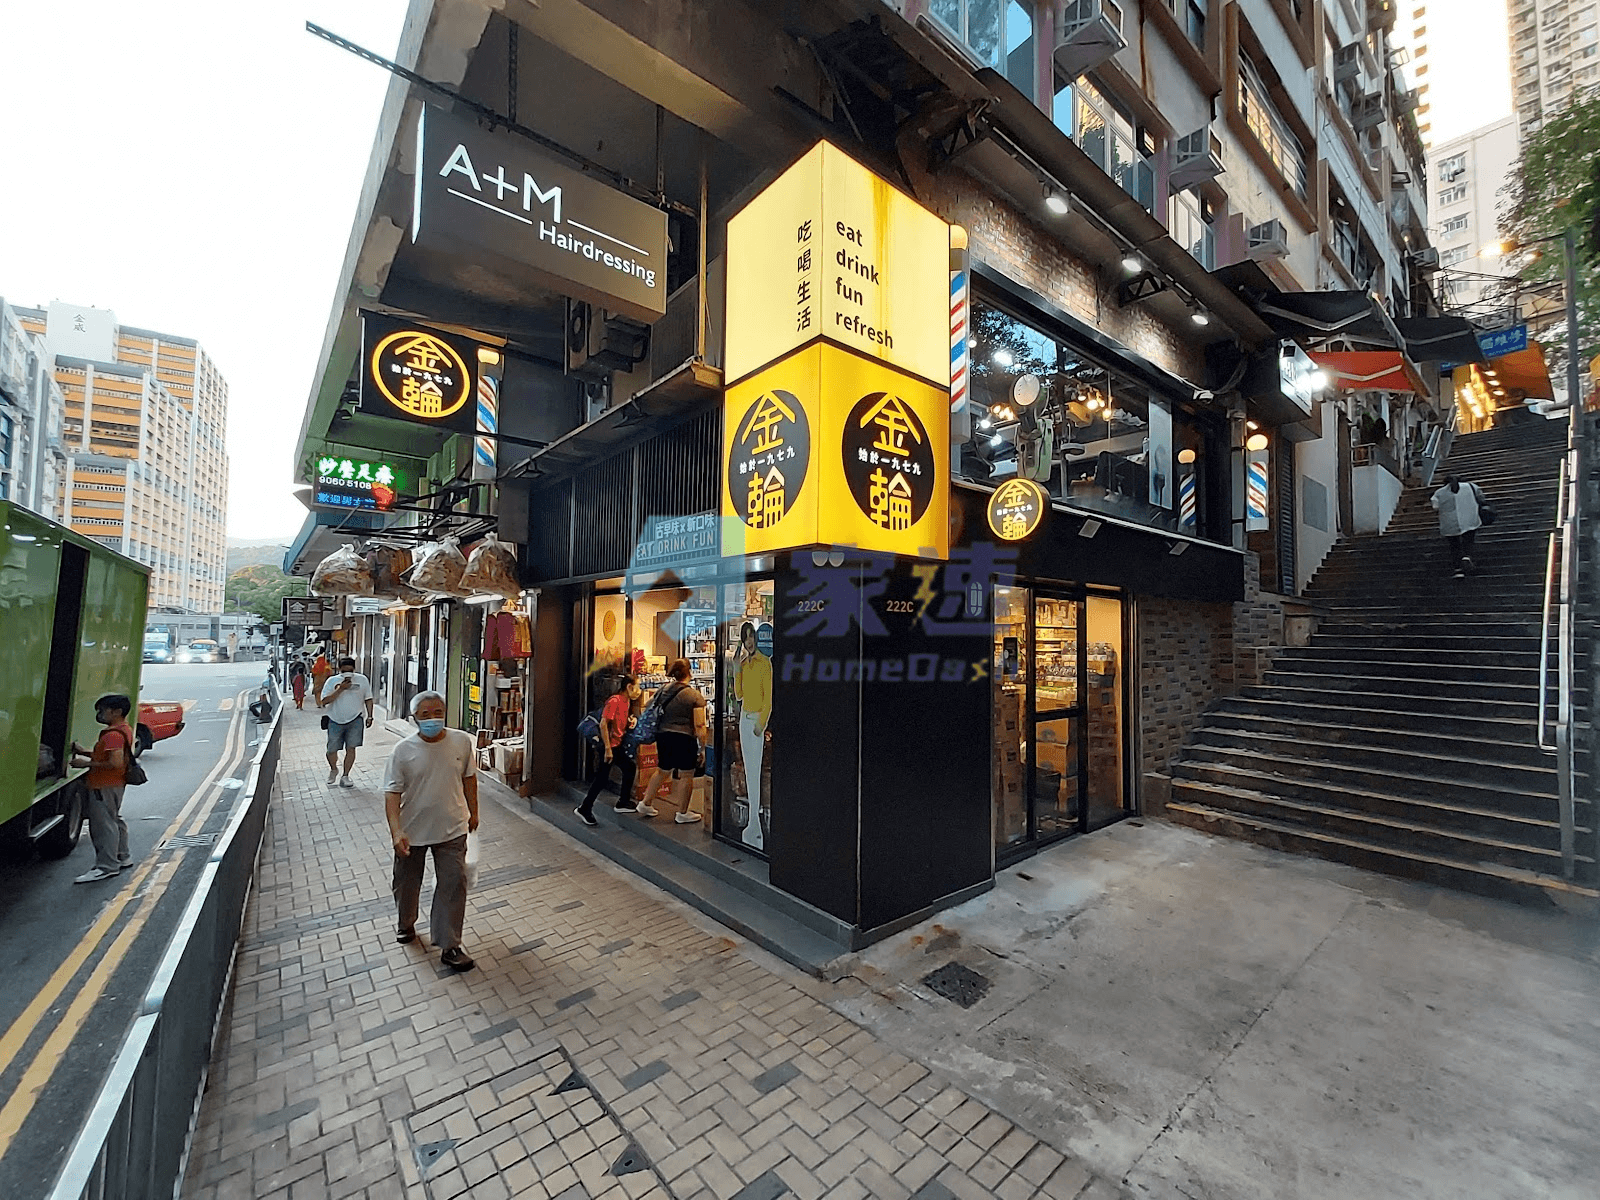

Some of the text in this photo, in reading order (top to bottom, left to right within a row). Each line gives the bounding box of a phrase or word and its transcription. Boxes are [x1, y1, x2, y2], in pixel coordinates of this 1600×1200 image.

[439, 143, 563, 224] A+M
[836, 221, 863, 247] eat
[539, 221, 656, 288] Hairdressing
[836, 248, 880, 285] drink
[796, 218, 812, 333] 吃喝生活
[835, 277, 864, 306] fun
[835, 310, 894, 349] refresh
[741, 391, 796, 456] 金
[860, 392, 922, 457] 金
[739, 445, 796, 475] 始於一九七九
[858, 447, 922, 476] 始於一九七九
[319, 476, 372, 490] 9060 5108
[747, 465, 786, 528] 輪
[869, 467, 912, 530] 輪
[658, 536, 687, 555] DRINK
[692, 530, 714, 548] FUN
[797, 600, 825, 612] 222C
[886, 600, 914, 612] 222C
